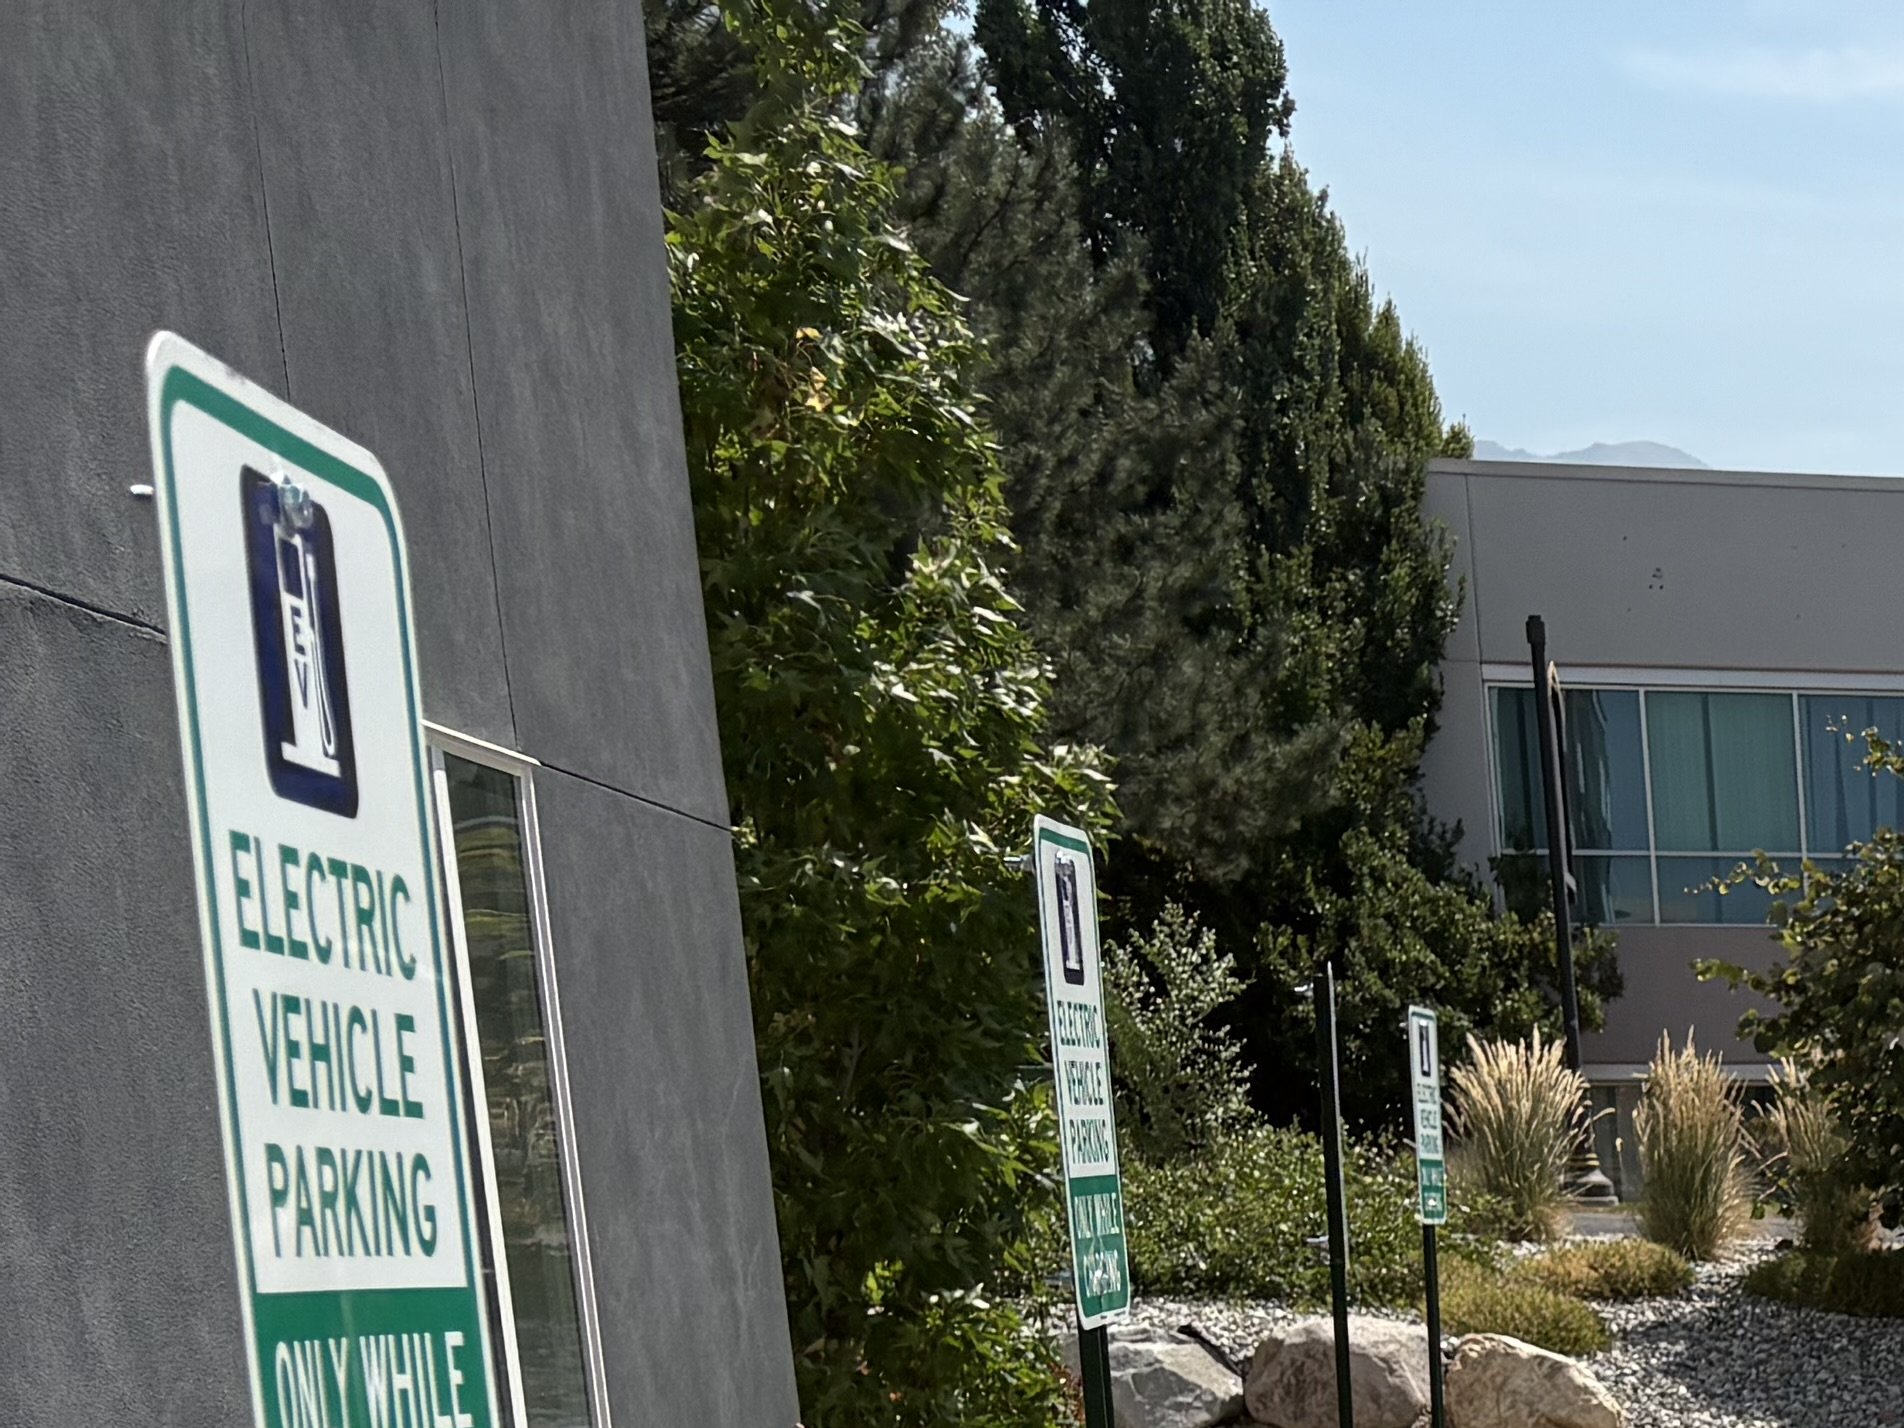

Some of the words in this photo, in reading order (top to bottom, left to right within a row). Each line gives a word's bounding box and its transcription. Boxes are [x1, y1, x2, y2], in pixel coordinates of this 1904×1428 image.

[229, 829, 417, 981] ELECTRIC
[253, 988, 425, 1119] VEHICLE
[264, 1143, 438, 1258] PARKING
